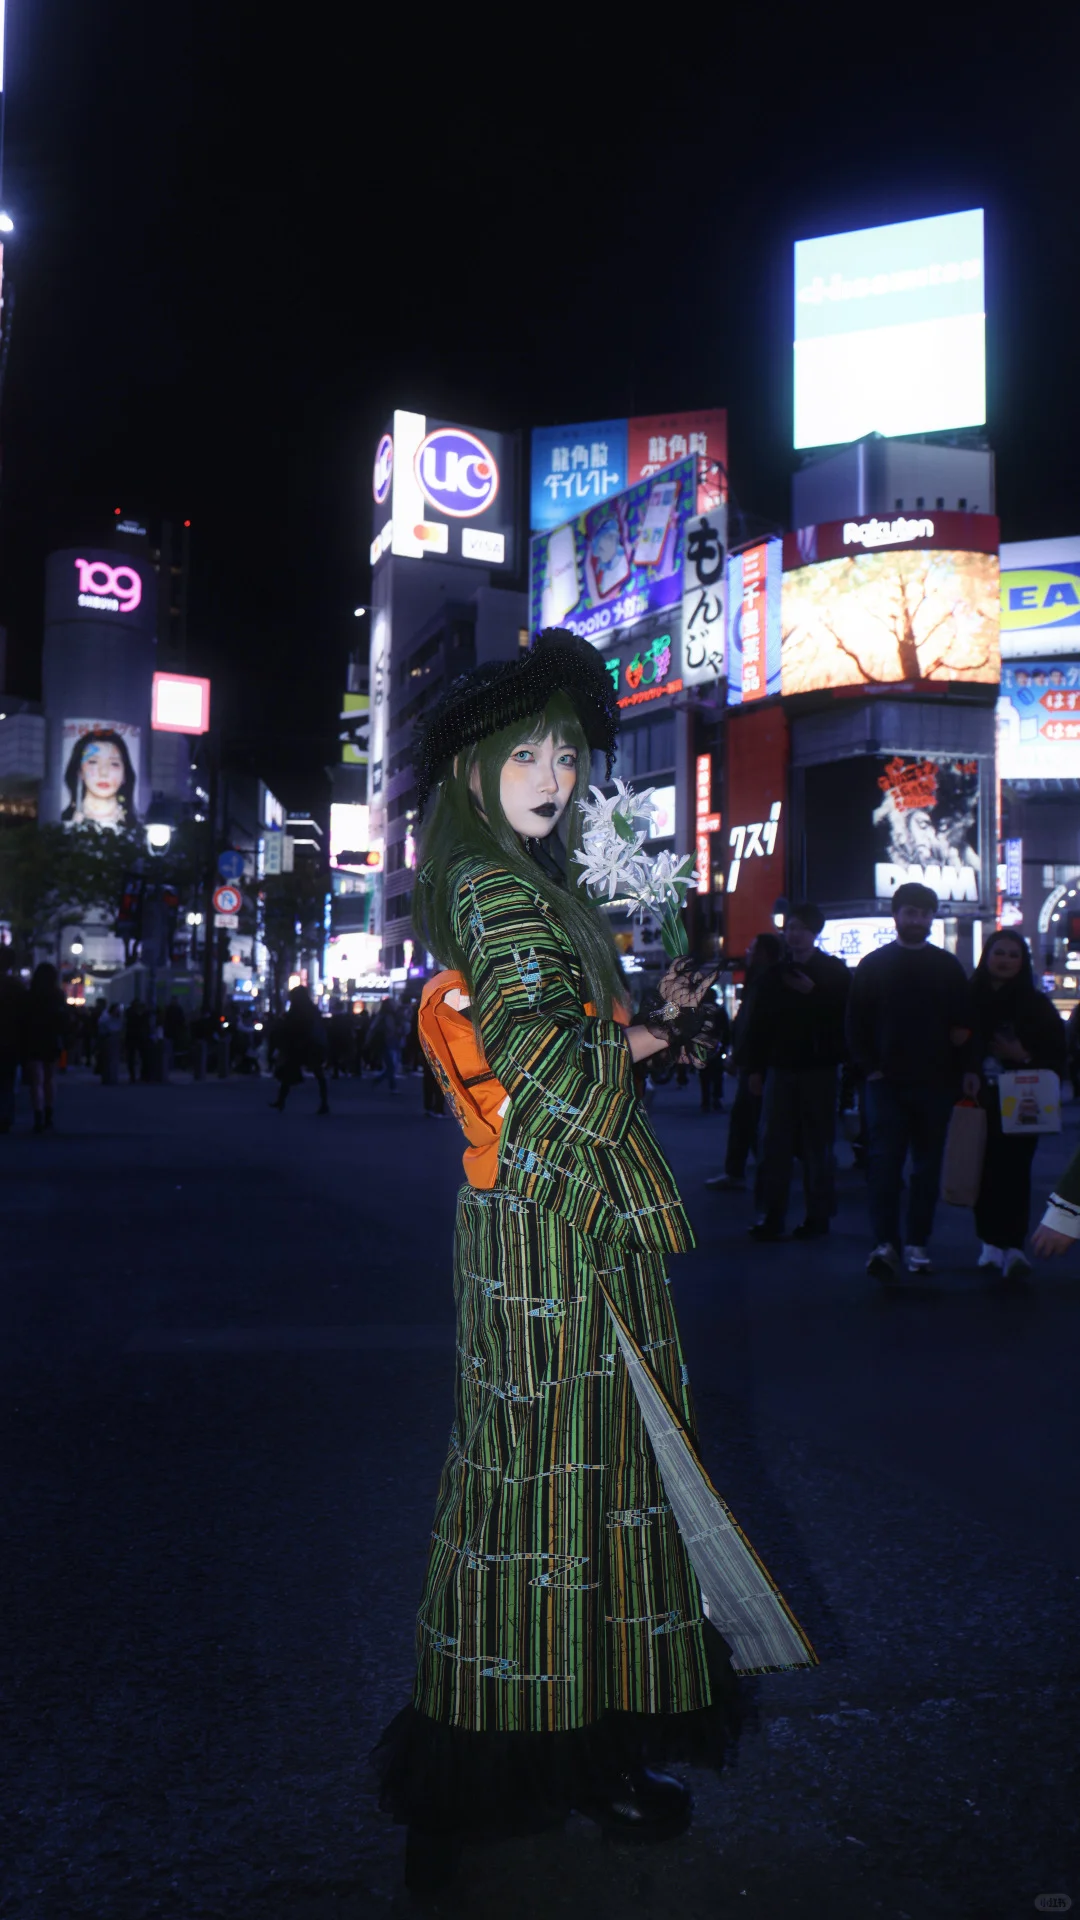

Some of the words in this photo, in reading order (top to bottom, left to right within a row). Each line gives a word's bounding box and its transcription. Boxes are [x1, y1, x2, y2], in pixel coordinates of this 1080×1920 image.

[544, 469, 620, 500] ダイレクト
[469, 539, 502, 554] VISA
[843, 517, 935, 548] Rakuten
[74, 558, 142, 613] 109
[687, 516, 724, 675] もんじゃ
[1000, 582, 1080, 612] EA
